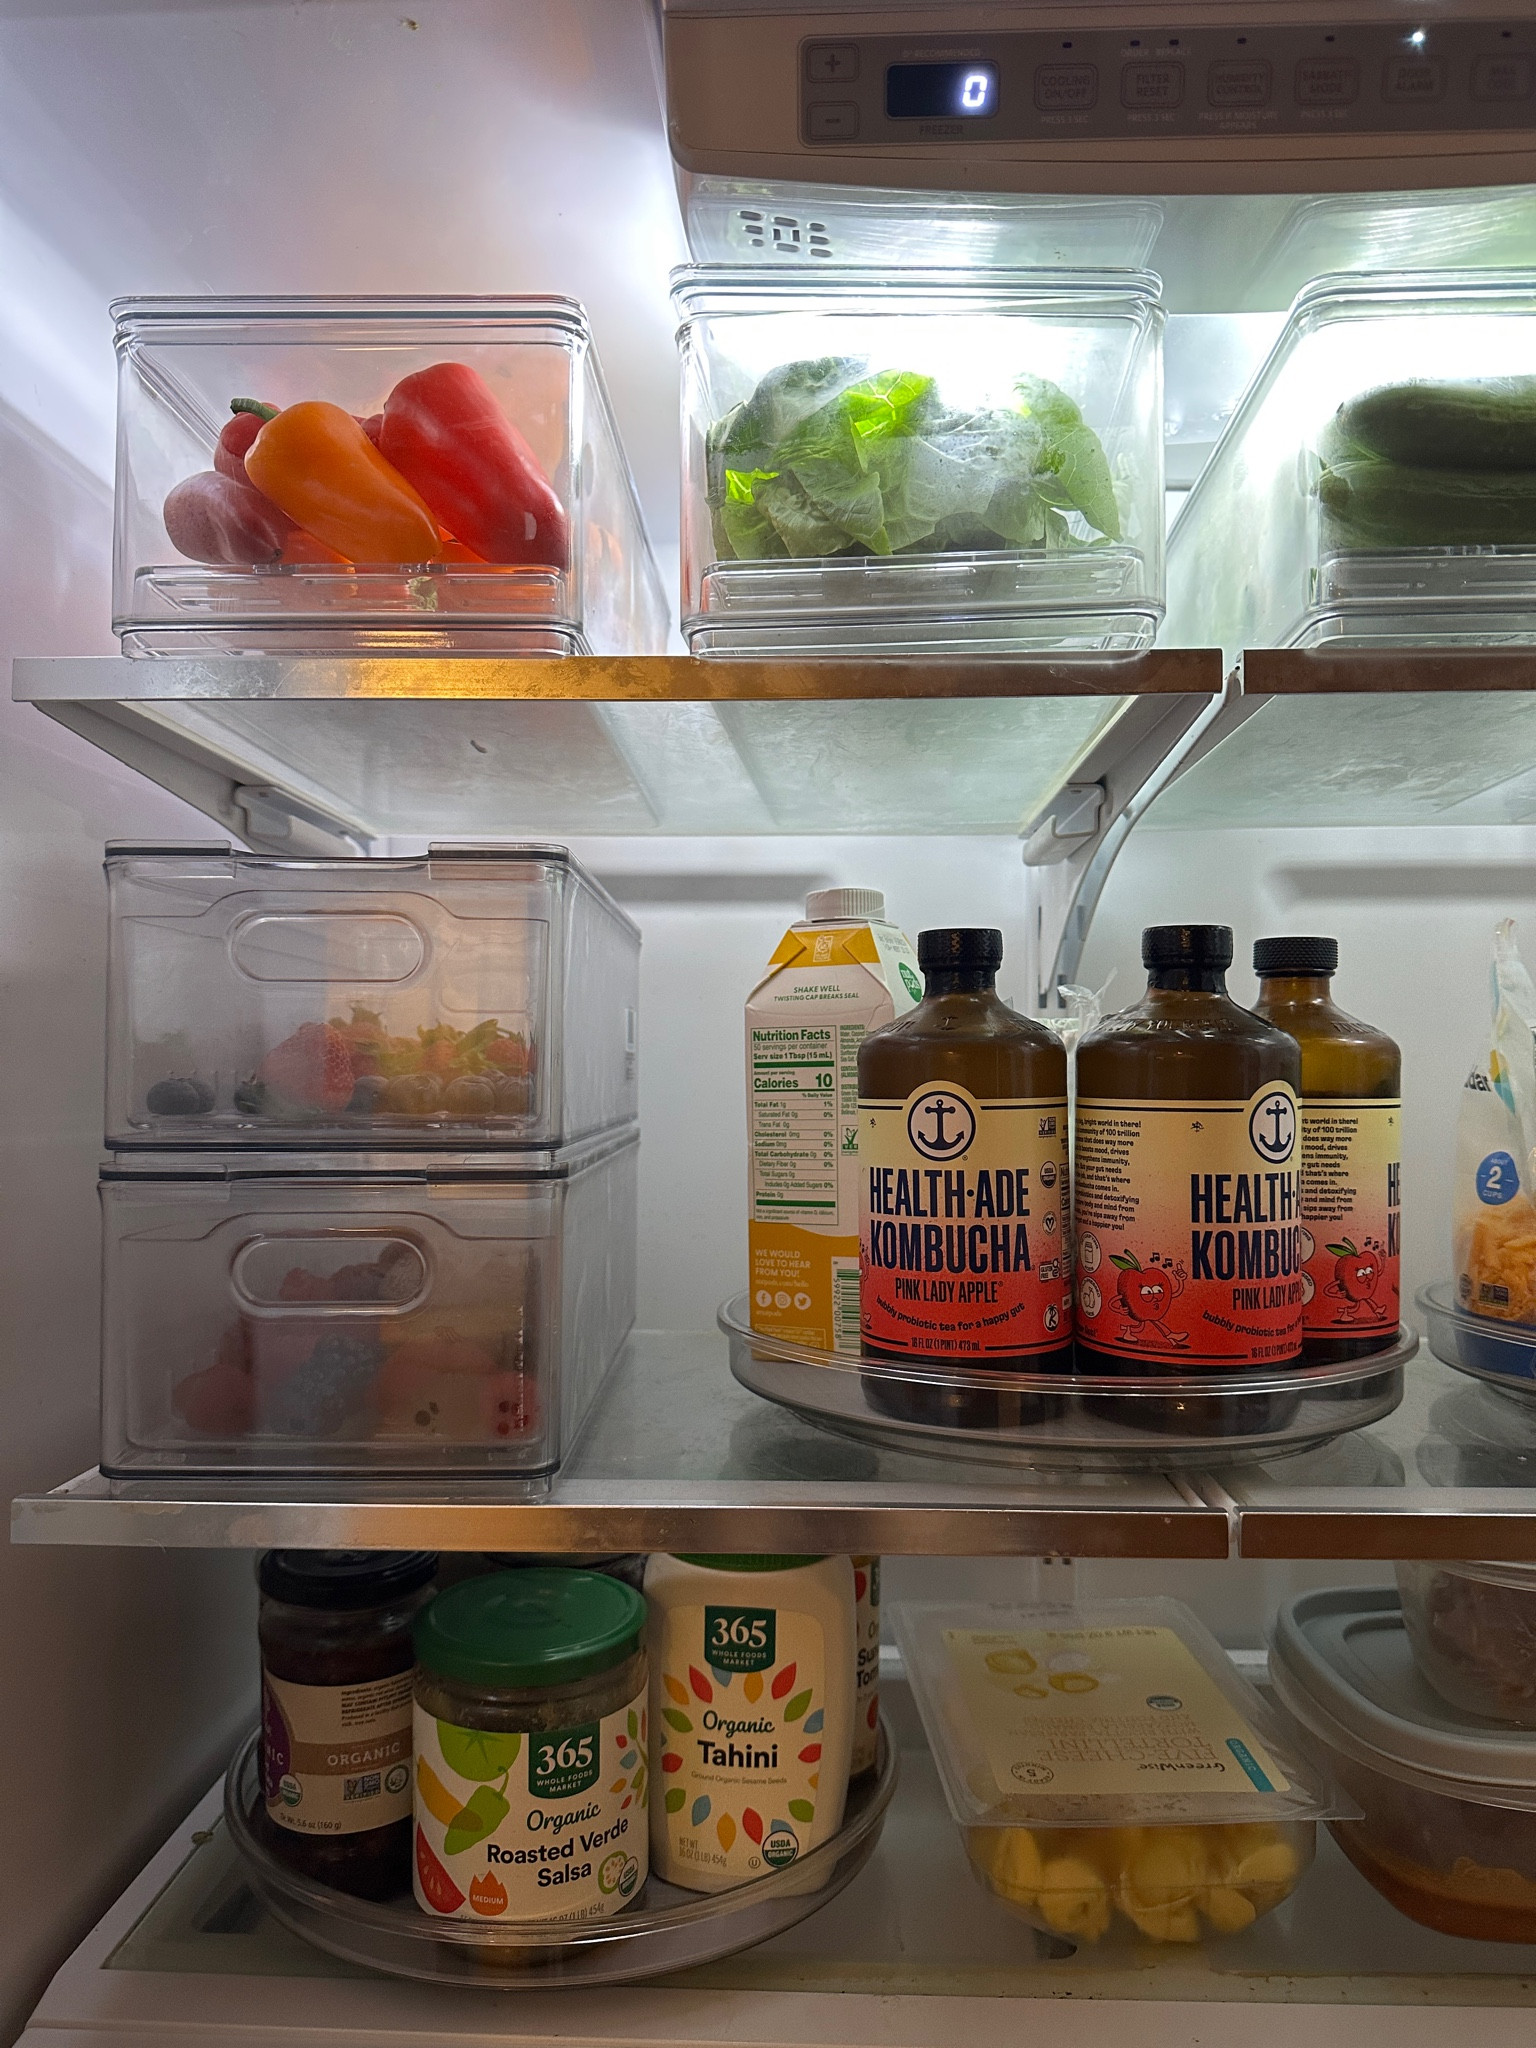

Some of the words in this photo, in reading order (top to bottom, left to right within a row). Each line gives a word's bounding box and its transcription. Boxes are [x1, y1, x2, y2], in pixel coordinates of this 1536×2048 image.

[1041, 74, 1090, 87] COOLING
[1136, 73, 1170, 85] FILTER
[962, 74, 988, 107] 0
[1045, 87, 1087, 100] ON/OFF
[1136, 86, 1169, 97] RESET
[1216, 84, 1261, 95] CONTROL
[1309, 82, 1343, 93] MODE
[919, 124, 964, 135] FREEZER
[793, 985, 819, 994] SHAKE
[774, 994, 804, 1002] TWISTING
[753, 1029, 799, 1041] Nutrition
[800, 1028, 830, 1040] Facts
[753, 1043, 761, 1051] 50
[762, 1043, 786, 1051] servings
[799, 1041, 827, 1049] container
[770, 1052, 783, 1060] size
[789, 1052, 805, 1060] Tbsp
[807, 1052, 817, 1060] (15
[753, 1077, 799, 1089] Calories
[815, 1073, 833, 1088] 10
[1116, 1129, 1140, 1138] trillion
[1094, 1146, 1109, 1155] mood,
[1110, 1148, 1129, 1156] drives
[1315, 1153, 1348, 1161] immunity,
[1101, 1157, 1130, 1167] immunity,
[1105, 1166, 1122, 1174] needs
[1094, 1174, 1110, 1182] that's
[1111, 1176, 1131, 1184] where
[1486, 1165, 1502, 1190] 2
[1318, 1187, 1357, 1196] detoxifying
[1482, 1189, 1503, 1199] CUPS
[1103, 1194, 1140, 1205] detoxifying
[1303, 1205, 1317, 1213] sips
[1318, 1205, 1336, 1213] away
[1118, 1213, 1135, 1222] from
[871, 1219, 1031, 1273] KOMBUCHA
[755, 1249, 767, 1257] WE
[769, 1250, 800, 1258] WOULD
[755, 1258, 776, 1267] LOVE
[777, 1259, 787, 1268] TO
[789, 1260, 811, 1269] HEAR
[755, 1267, 778, 1276] FROM
[780, 1268, 800, 1277] YOU!
[895, 1277, 922, 1302] PINK
[923, 1279, 955, 1304] LADY
[1232, 1287, 1261, 1311] PINK
[1263, 1284, 1286, 1309] LADY
[876, 1294, 898, 1318] bubbly
[897, 1311, 938, 1331] probiotic
[939, 1321, 957, 1332] tea
[958, 1320, 974, 1331] for
[982, 1310, 1010, 1328] happy
[1010, 1301, 1025, 1319] gut
[1202, 1309, 1234, 1332] bubbly
[1235, 1323, 1274, 1338] probiotic
[1275, 1327, 1287, 1337] tea
[918, 1338, 925, 1348] FL
[925, 1338, 933, 1349] OZ
[959, 1340, 971, 1350] 473
[972, 1340, 980, 1351] mL
[712, 1615, 768, 1648] 365
[712, 1649, 738, 1658] WHOLE
[740, 1650, 767, 1659] FOODS
[723, 1657, 755, 1666] MARKET
[702, 1709, 776, 1740] Organic
[1046, 1736, 1212, 1750] TORTELLINI
[327, 1743, 400, 1766] ORGANIC
[536, 1734, 593, 1776] 365
[697, 1738, 779, 1770] Tahini
[1037, 1748, 1219, 1763] FIVE-CHEESE
[1139, 1761, 1227, 1774] GreenWise
[536, 1776, 567, 1787] WHOLE
[568, 1769, 593, 1781] FOODS
[549, 1780, 581, 1793] MARKET
[526, 1801, 602, 1835] Organic
[487, 1837, 574, 1864] Roasted
[579, 1817, 629, 1853] Verde
[679, 1837, 690, 1848] NET
[690, 1840, 698, 1849] WT
[770, 1839, 791, 1849] USDA
[767, 1848, 794, 1859] ORGANIC
[537, 1862, 592, 1888] Salsa
[472, 1893, 504, 1905] MEDIUM
